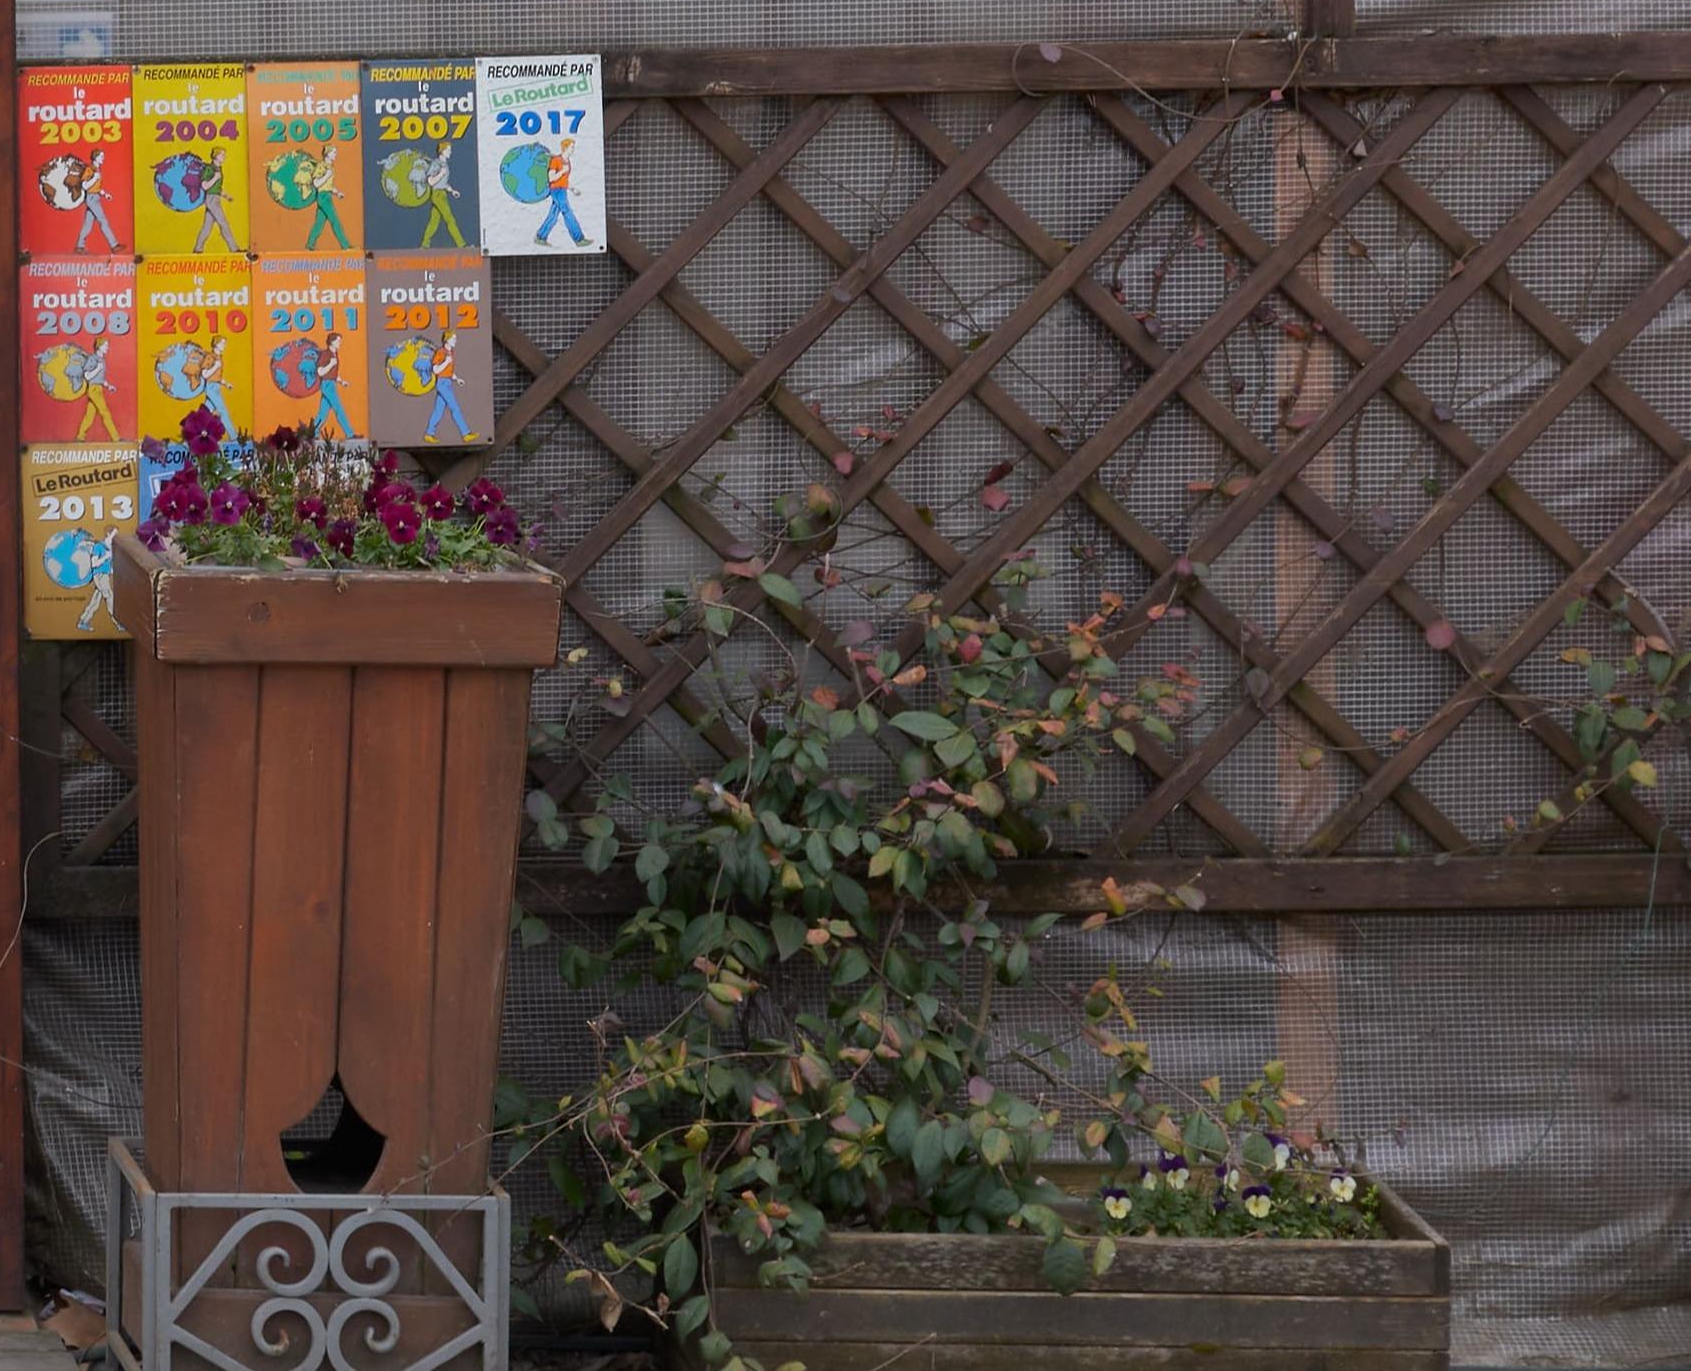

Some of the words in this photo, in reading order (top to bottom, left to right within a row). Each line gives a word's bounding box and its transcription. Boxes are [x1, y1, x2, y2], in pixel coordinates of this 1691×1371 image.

[108, 72, 130, 84] PAR
[222, 68, 244, 79] PAR
[454, 66, 476, 80] PAR
[488, 63, 568, 78] RECOMMANDÉ
[571, 63, 593, 77] PAR
[73, 87, 86, 99] le
[187, 83, 199, 93] le
[304, 84, 314, 94] le
[418, 81, 429, 92] le
[28, 97, 131, 122] routard
[143, 94, 244, 115] routard
[261, 95, 360, 116] routard
[375, 92, 474, 114] routard
[40, 120, 122, 144] 2003
[155, 120, 239, 142] 2004
[266, 118, 358, 142] 2005
[379, 115, 473, 141] 2007
[496, 110, 585, 136] 2017
[113, 262, 136, 276] PAR
[230, 260, 252, 273] PAR
[424, 270, 436, 282] le
[76, 277, 88, 287] le
[193, 275, 204, 285] le
[309, 273, 320, 284] le
[33, 289, 132, 308] routard
[151, 287, 249, 307] routard
[266, 285, 365, 305] routard
[381, 282, 479, 303] routard
[36, 311, 131, 335] 2008
[155, 310, 248, 334] 2010
[270, 308, 358, 332] 2011
[384, 304, 479, 330] 2012
[114, 450, 137, 463] PAR
[39, 495, 134, 520] 2013
